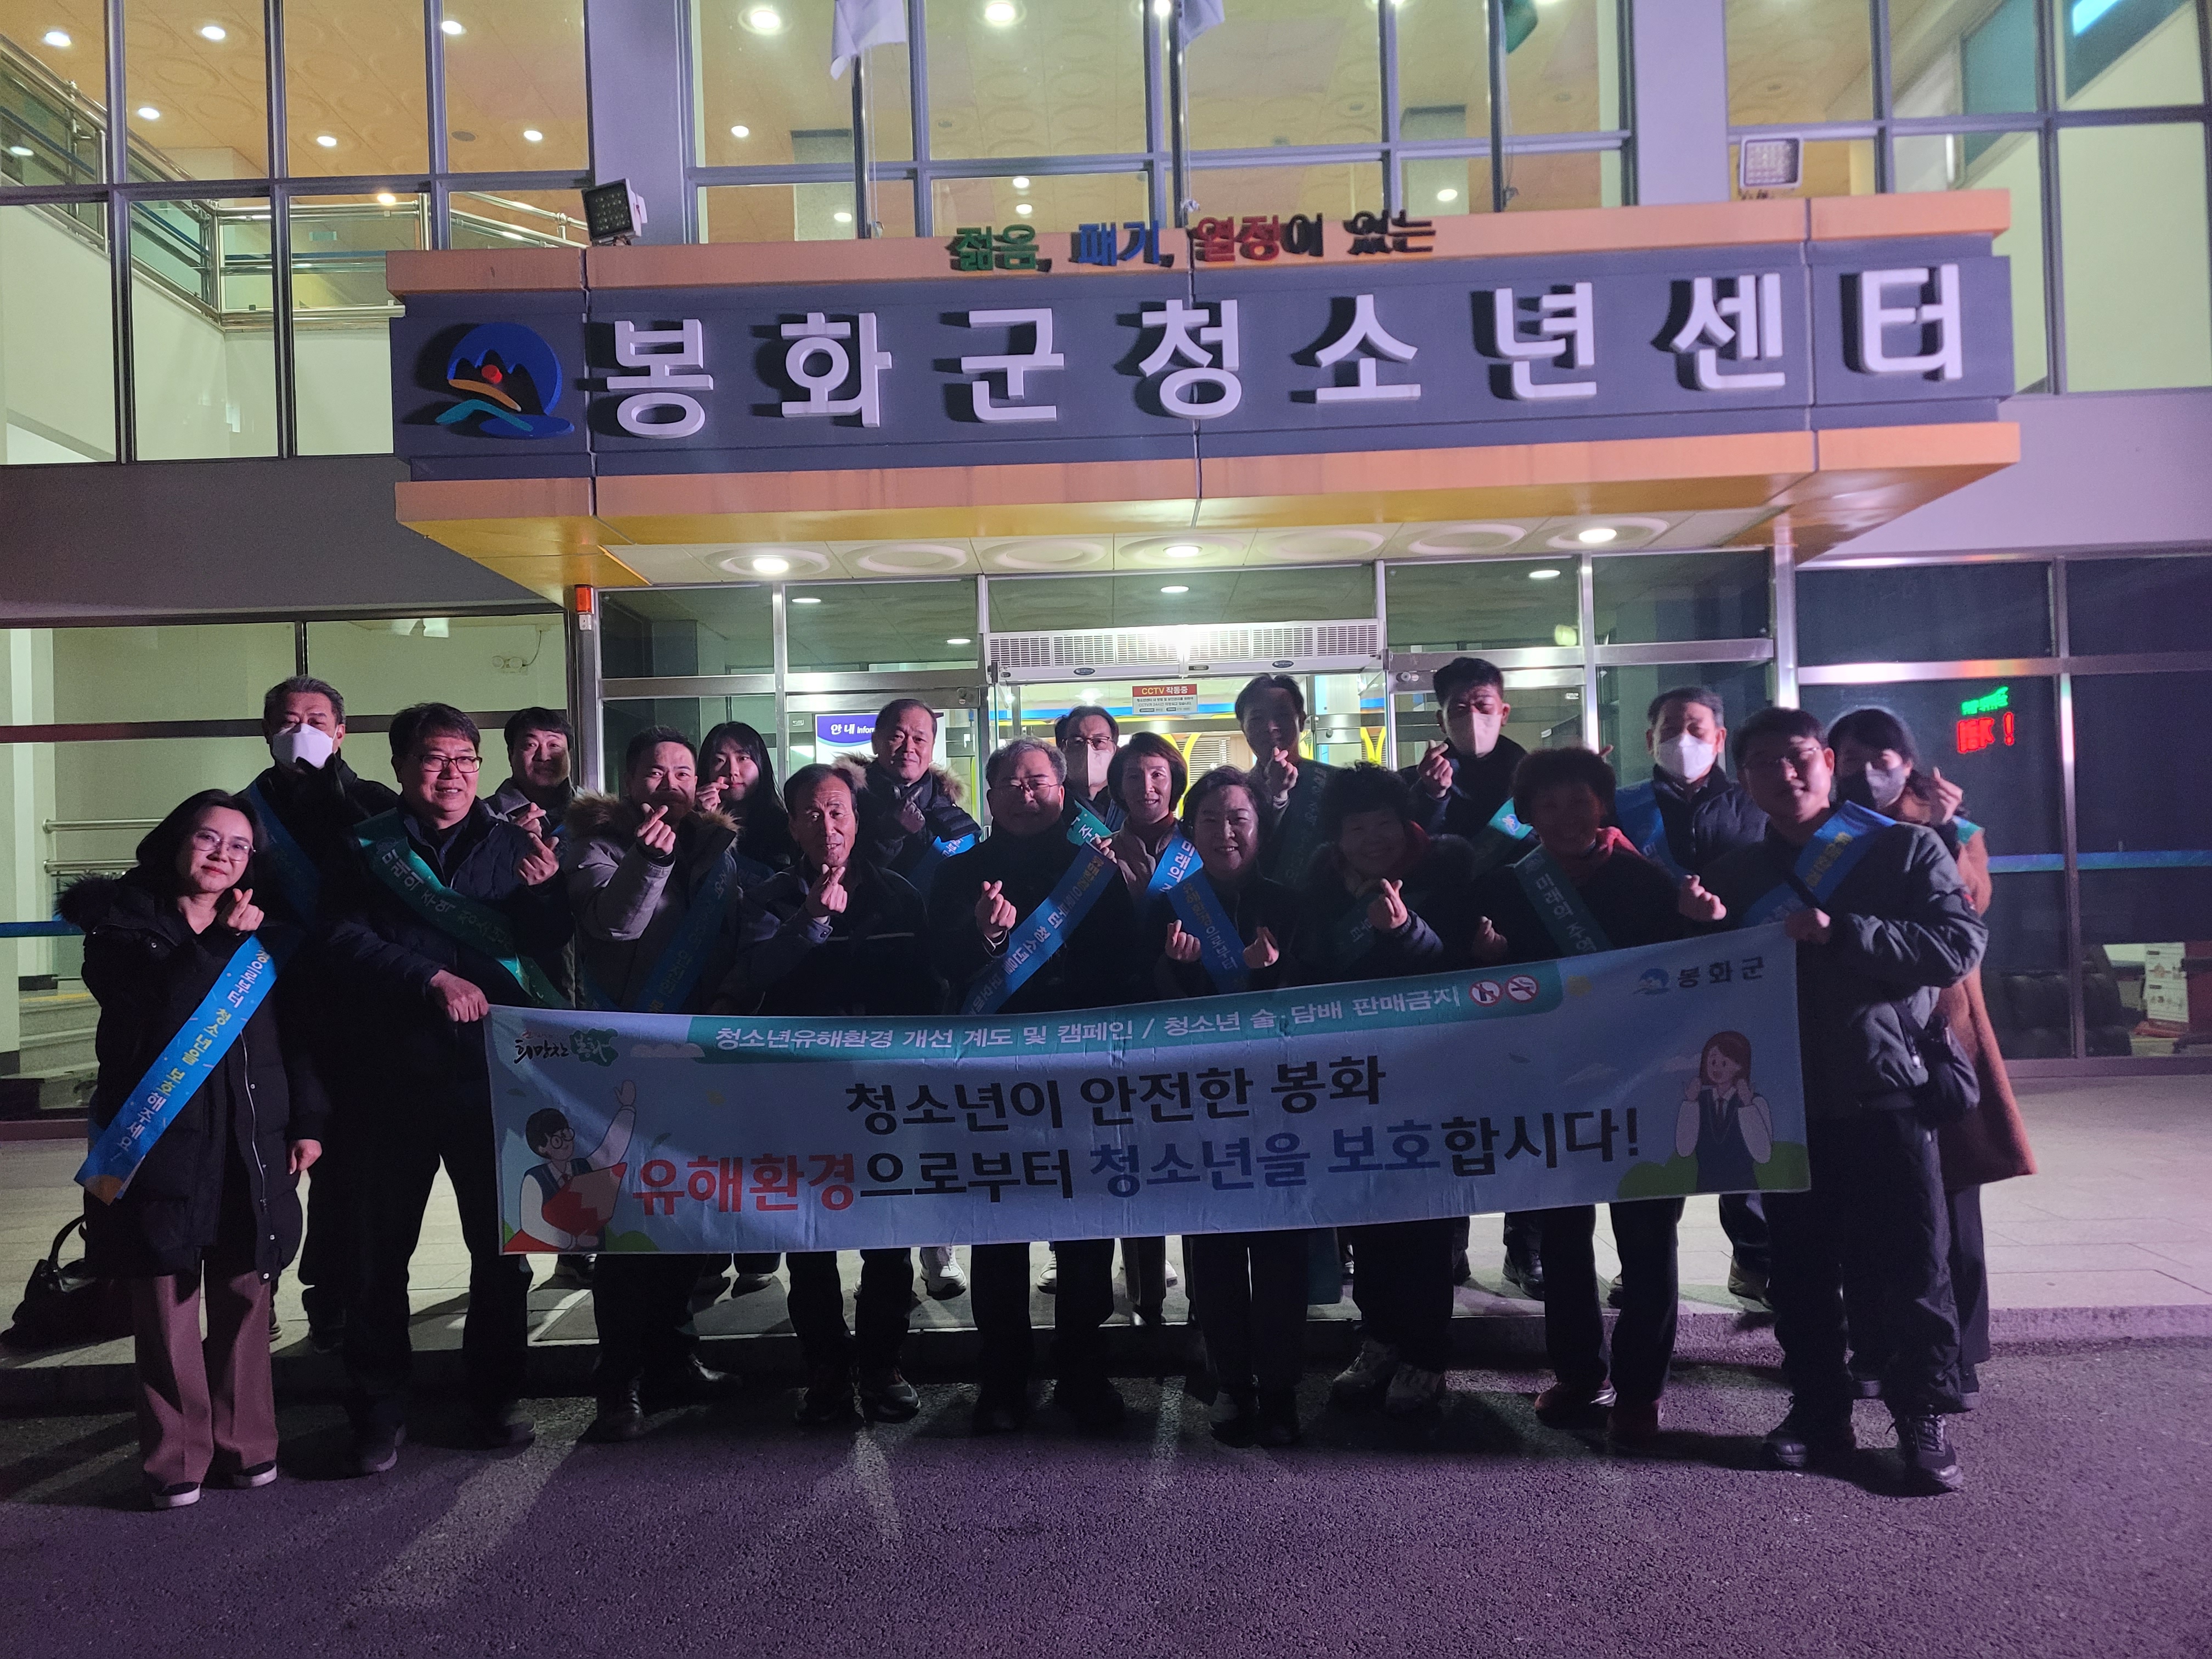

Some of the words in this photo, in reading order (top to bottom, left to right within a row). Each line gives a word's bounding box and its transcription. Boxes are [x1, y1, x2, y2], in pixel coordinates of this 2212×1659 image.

[1198, 212, 1323, 262] 열정이
[1347, 210, 1436, 256] 있는
[1166, 686, 1188, 694] 작동중
[1167, 839, 1196, 883] 미래의
[1002, 926, 1051, 975] 청소년을
[1677, 956, 1764, 988] 봉화군
[182, 1008, 232, 1066] 청소년을
[715, 1028, 893, 1050] 청소년유해환경
[902, 1029, 953, 1049] 개선
[963, 1028, 1013, 1047] 계도
[1023, 1025, 1047, 1045] 및
[1058, 1020, 1133, 1043] 캠페인
[1164, 1011, 1241, 1037] 청소년
[1352, 986, 1461, 1017] 판매금지
[845, 1080, 1063, 1135] 청소년이
[1080, 1068, 1254, 1126] 안전한
[1271, 1055, 1386, 1114] 봉화
[633, 1149, 1073, 1216] 유해환경으로부터
[1090, 1132, 1311, 1198] 청소년을
[1328, 1108, 1638, 1177] 보호합시다!
